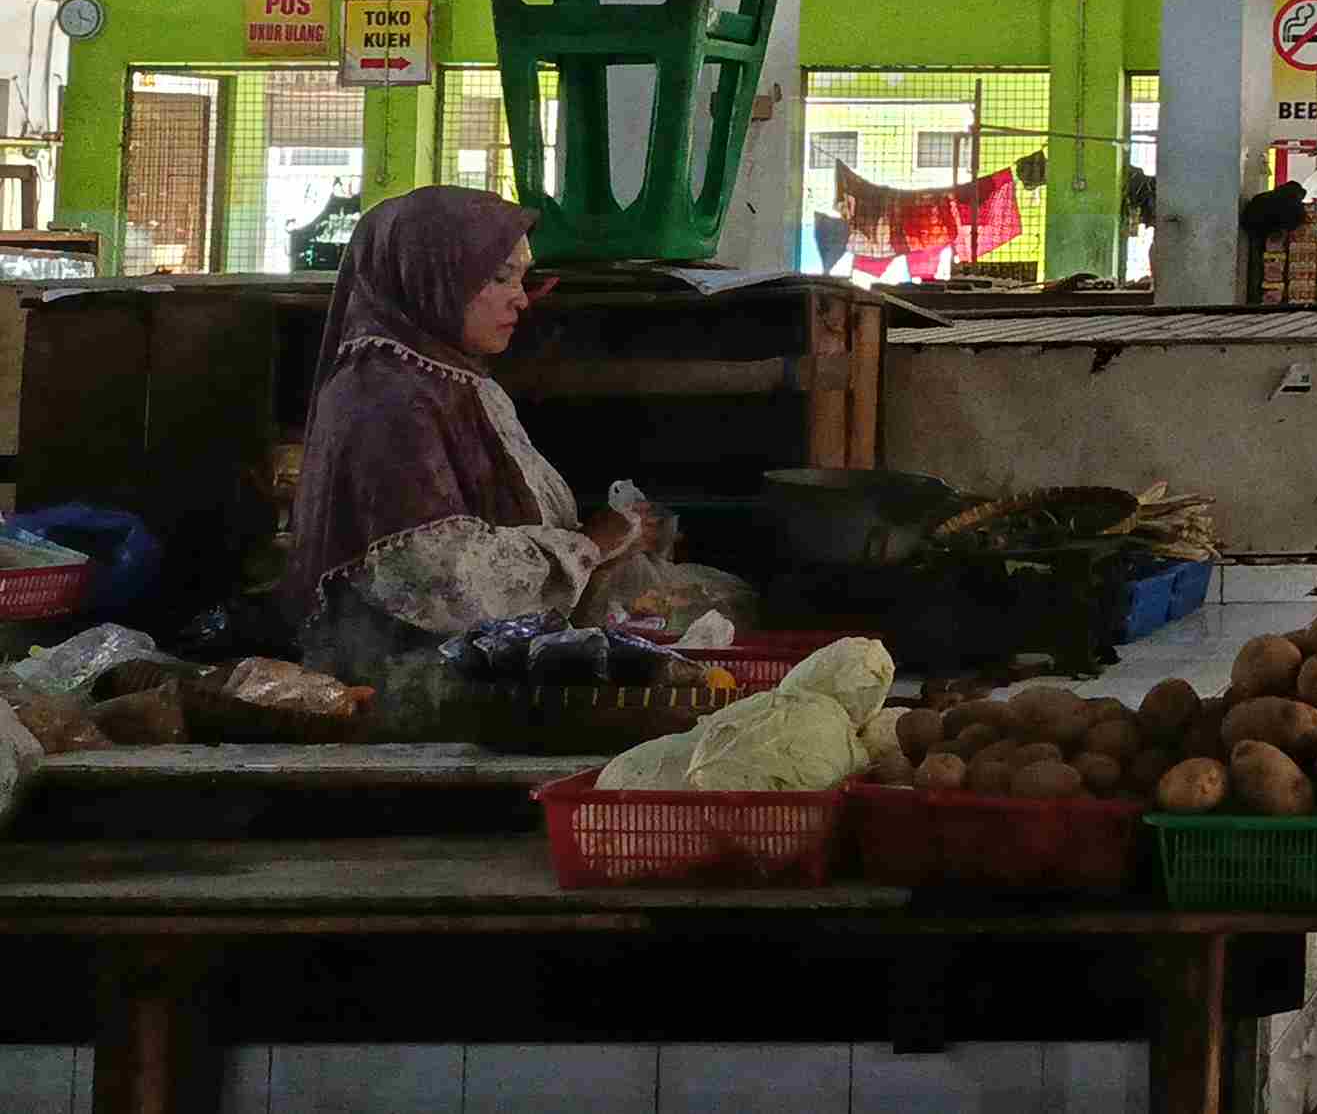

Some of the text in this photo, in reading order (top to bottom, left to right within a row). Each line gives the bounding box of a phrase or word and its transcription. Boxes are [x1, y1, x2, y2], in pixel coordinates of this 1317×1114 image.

[363, 10, 411, 26] TOKO
[249, 23, 325, 42] UKUR ULANG
[363, 32, 411, 48] KUEH
